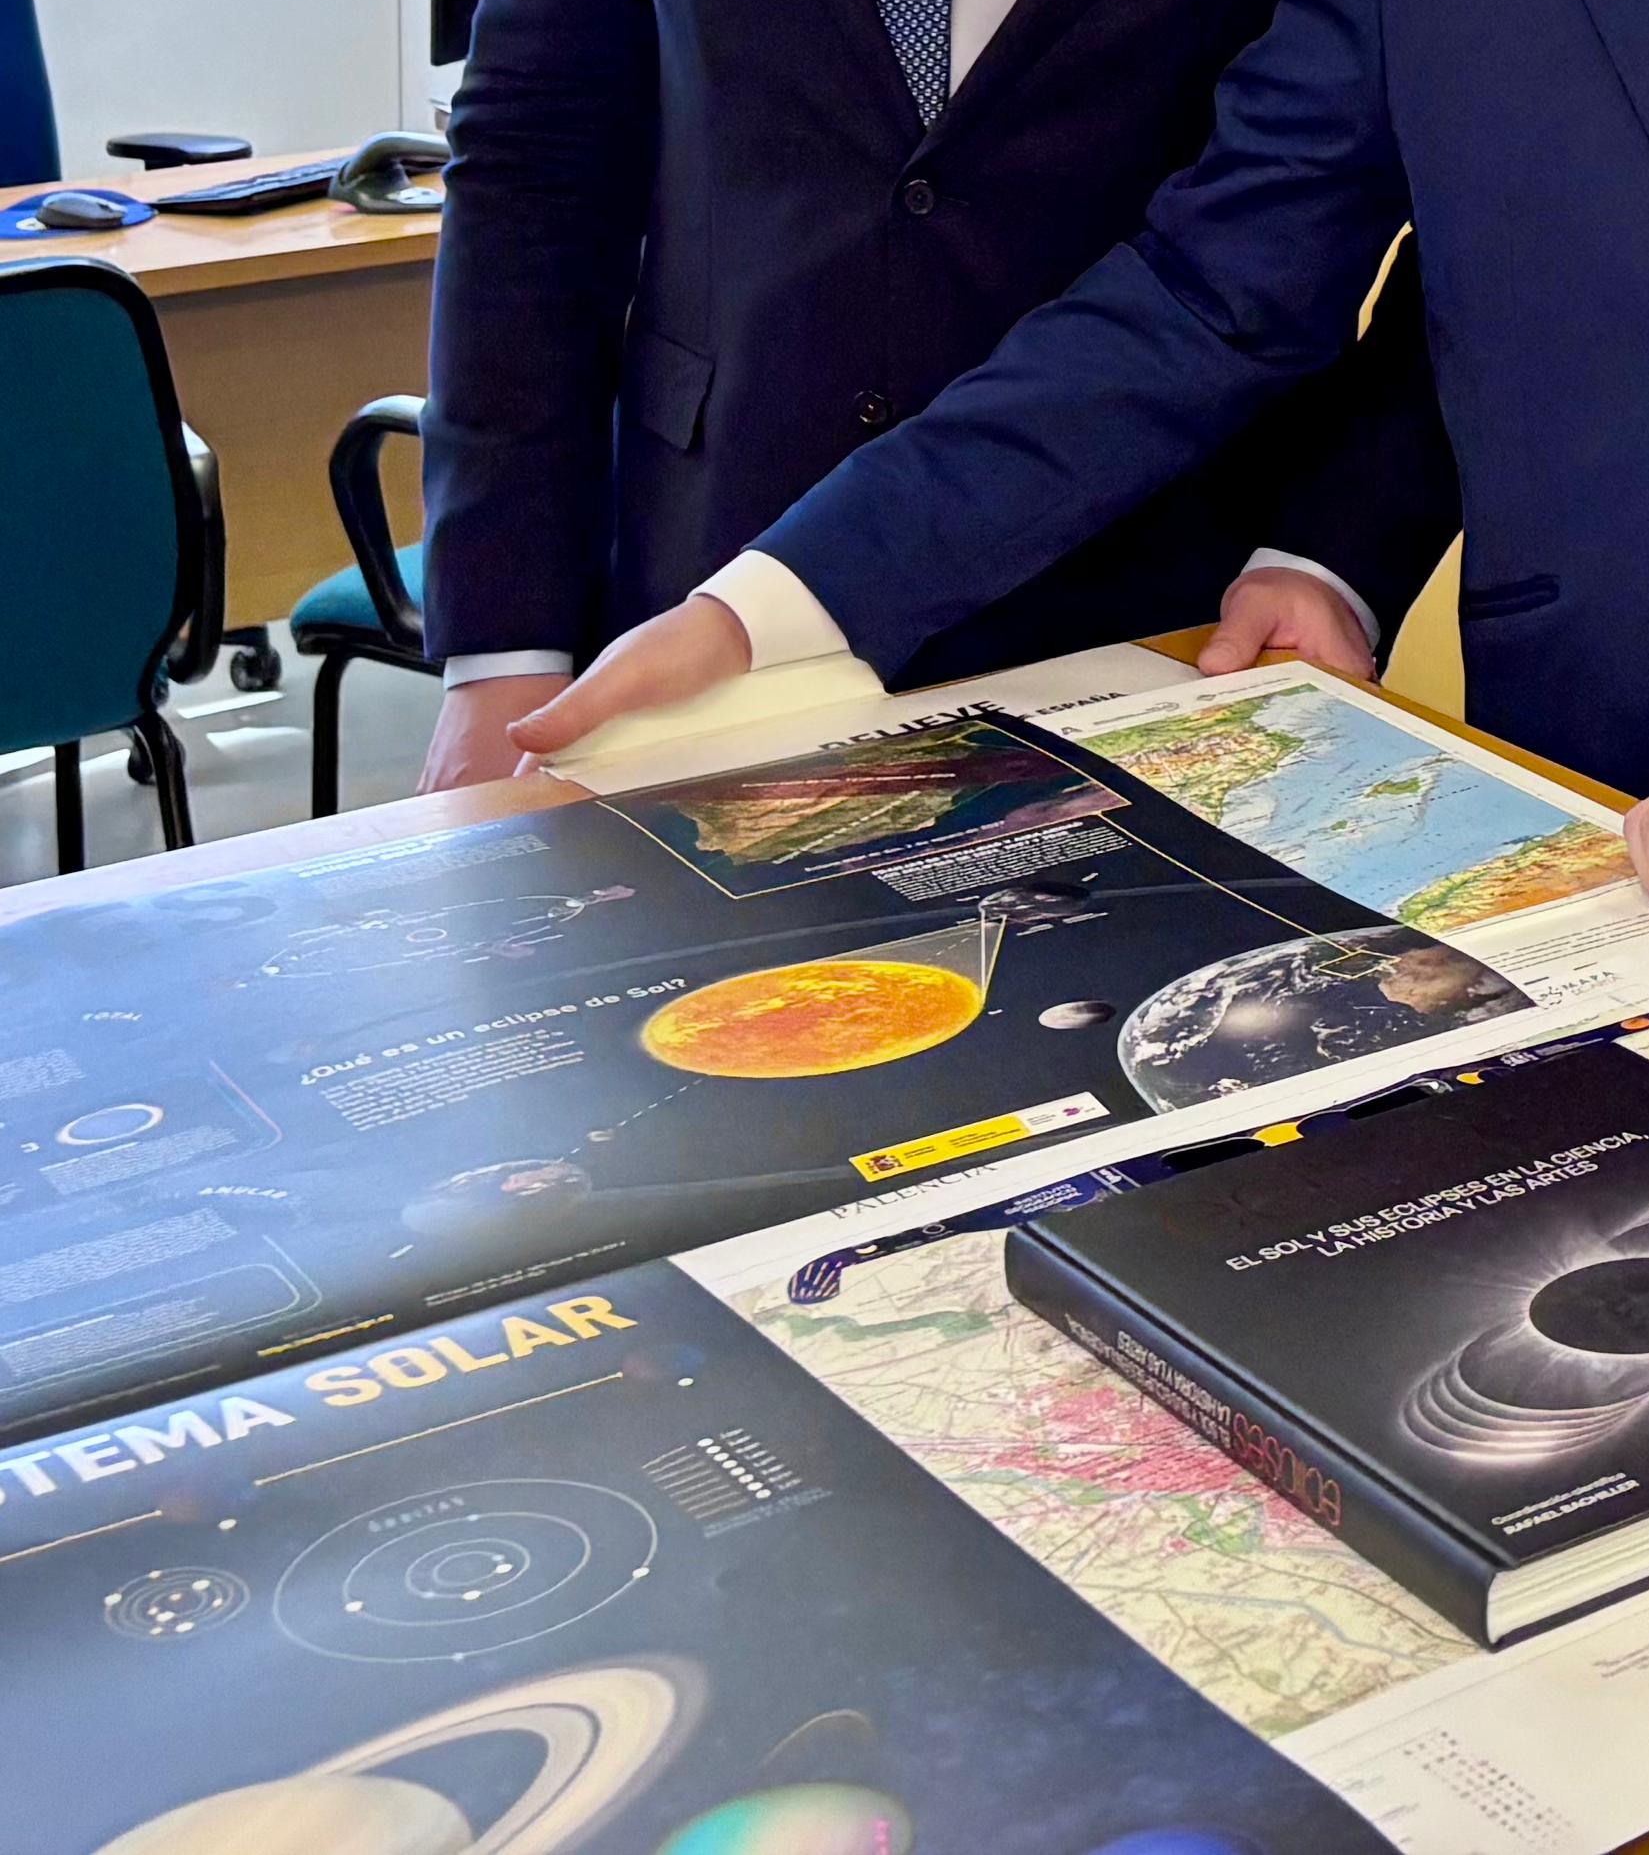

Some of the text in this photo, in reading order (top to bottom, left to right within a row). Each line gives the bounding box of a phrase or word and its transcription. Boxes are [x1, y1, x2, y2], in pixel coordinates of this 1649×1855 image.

[1034, 689, 1128, 722] ESPAÑA
[300, 976, 690, 1087] ¿Qué es un eclipse de Sol?
[1226, 1131, 1649, 1272] EL SOL Y SUS ECLIPSES EN LA CIENCIA,
[1316, 1159, 1600, 1259] LA HISTORIA Y LAS ARTES
[0, 1394, 297, 1508] TEMA
[303, 1294, 638, 1407] SOLAR
[1503, 1509, 1560, 1536] RAFAEL
